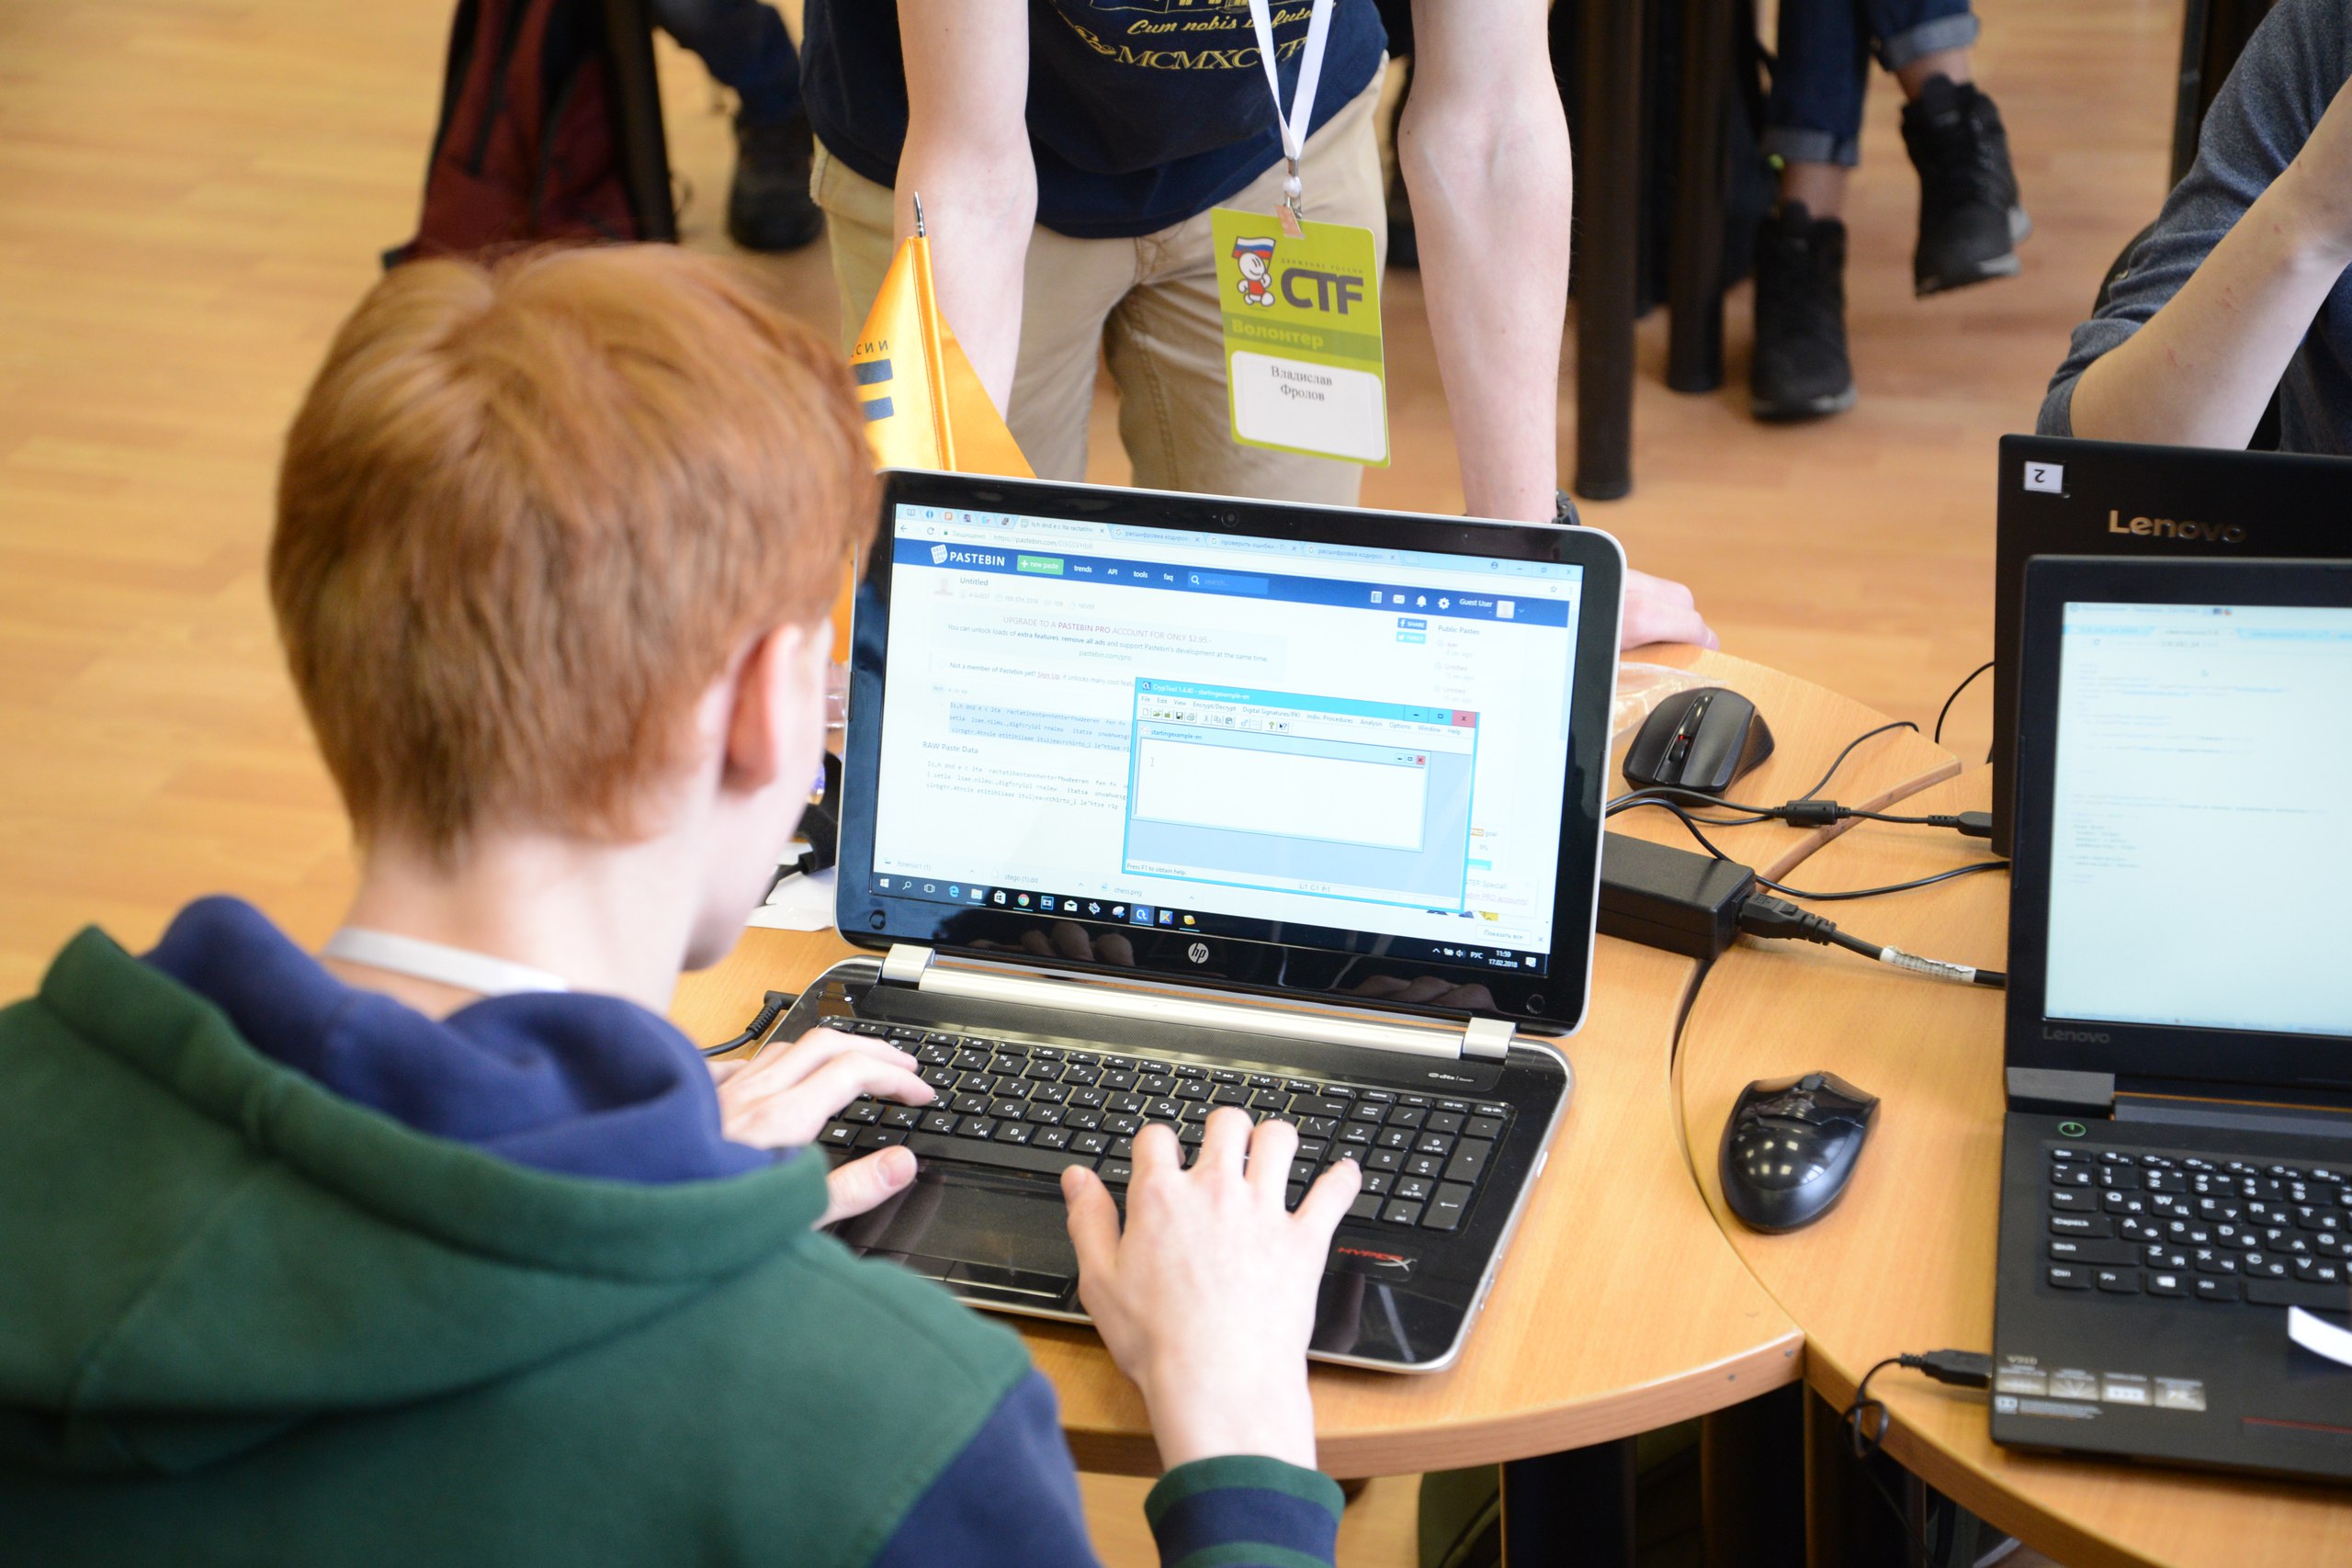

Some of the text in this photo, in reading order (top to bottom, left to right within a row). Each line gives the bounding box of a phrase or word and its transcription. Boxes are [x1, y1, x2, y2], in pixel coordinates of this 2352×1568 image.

[1127, 19, 1177, 35] Cum
[1182, 16, 1237, 30] nobis
[1281, 267, 1363, 315] CTF
[1232, 319, 1323, 350] Волонтер
[1271, 366, 1333, 386] Владислав
[1280, 384, 1325, 401] Фролов
[2108, 510, 2247, 543] Lenovo
[950, 551, 1005, 567] PASTEBIN
[1073, 565, 1174, 581] trends API tools faq
[960, 577, 989, 587] Untitled
[1459, 598, 1494, 608] Guest User
[1003, 616, 1037, 626] UPGRADE
[1057, 621, 1093, 632] PASTEBIN
[1094, 625, 1111, 634] PRO
[1113, 626, 1148, 637] ACCOUNT
[1150, 630, 1165, 639] FOR
[1167, 632, 1187, 642] ONLY
[1438, 625, 1480, 636] Public Pastes
[948, 624, 958, 632] You
[971, 626, 991, 635] unlock
[992, 628, 1008, 637] loads
[1061, 636, 1085, 644] remove
[1094, 637, 1105, 646] ads
[1120, 642, 1143, 651] support
[1175, 647, 1216, 659] development
[1224, 651, 1234, 660] the
[1079, 649, 1132, 661] pastebin.com/pro
[949, 661, 961, 670] Not
[967, 664, 990, 673] member
[999, 667, 1023, 676] Pastebin
[1037, 671, 1050, 680] Sign
[1360, 718, 1382, 728] Analysis
[1389, 722, 1411, 731] Options
[1419, 725, 1441, 734] Window
[1448, 728, 1461, 736] Help
[922, 741, 978, 754] RAW Paste Data
[1126, 863, 1141, 871] Press
[1155, 866, 1173, 874] obtain
[1190, 942, 1208, 963] hp
[2042, 1026, 2110, 1044] Lenovo
[2154, 1195, 2173, 1205] W
[2122, 1218, 2137, 1228] A
